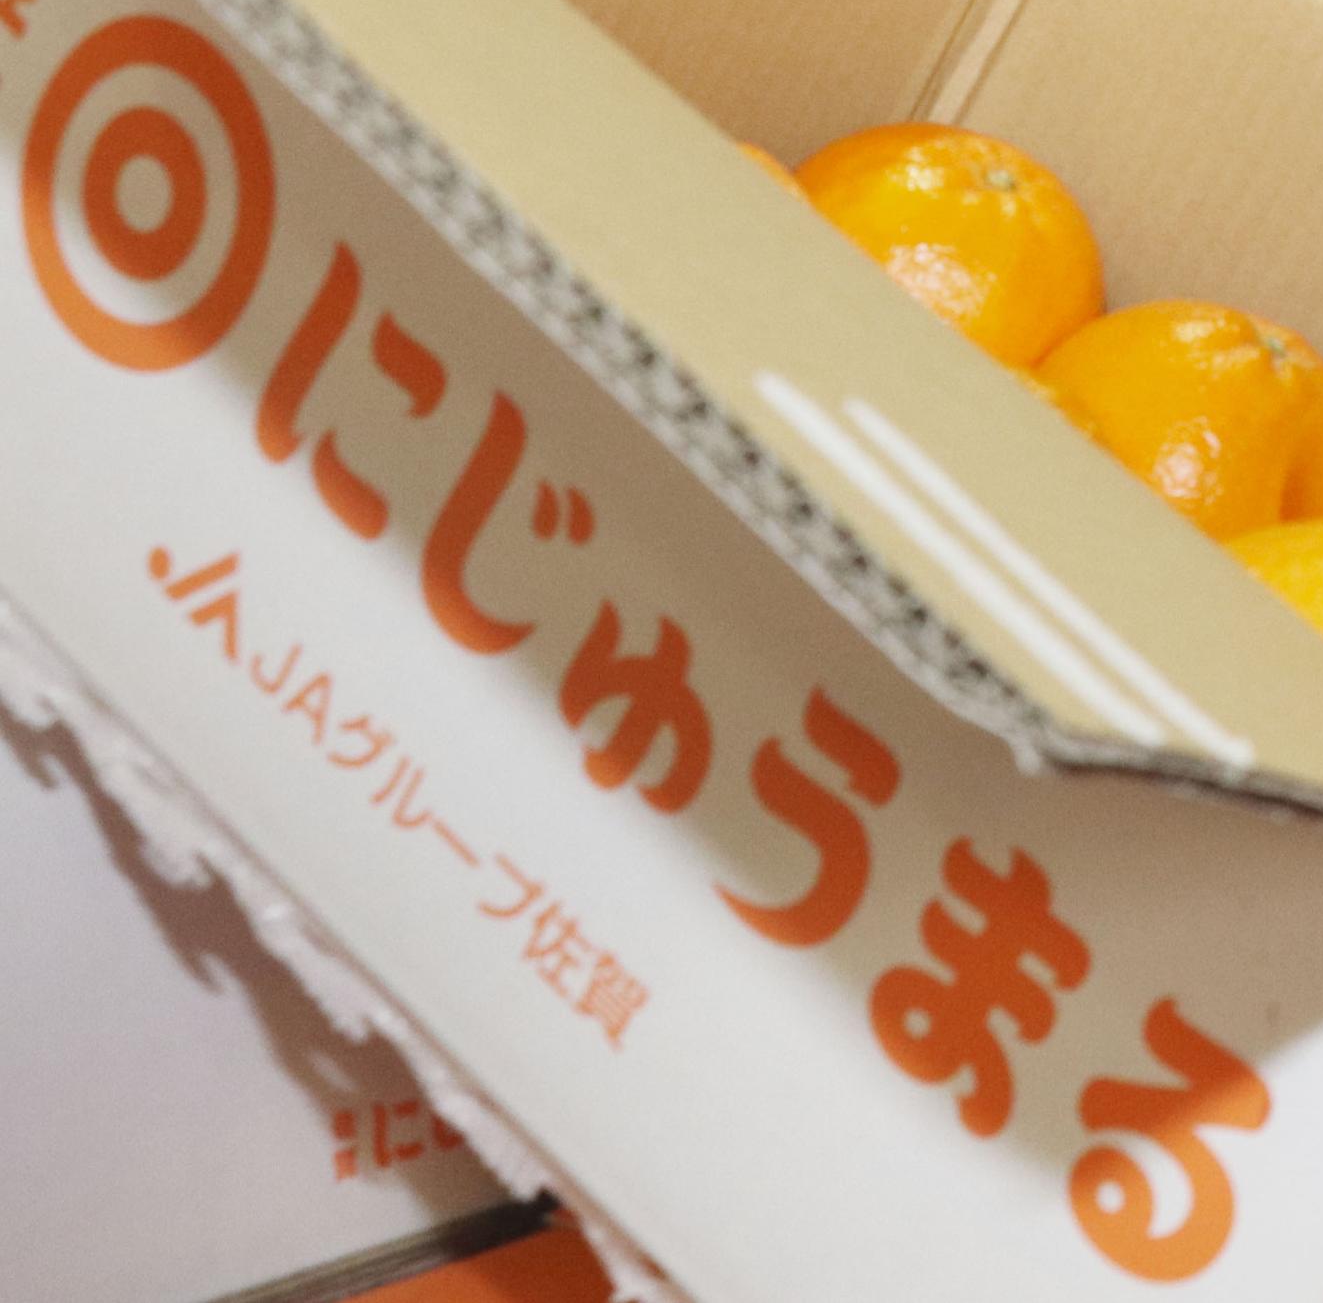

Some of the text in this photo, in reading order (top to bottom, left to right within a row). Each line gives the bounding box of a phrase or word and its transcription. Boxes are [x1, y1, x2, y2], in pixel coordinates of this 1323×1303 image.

[250, 641, 653, 1052] JAグループ佐賀
[256, 241, 1272, 1282] にじゅうまる
